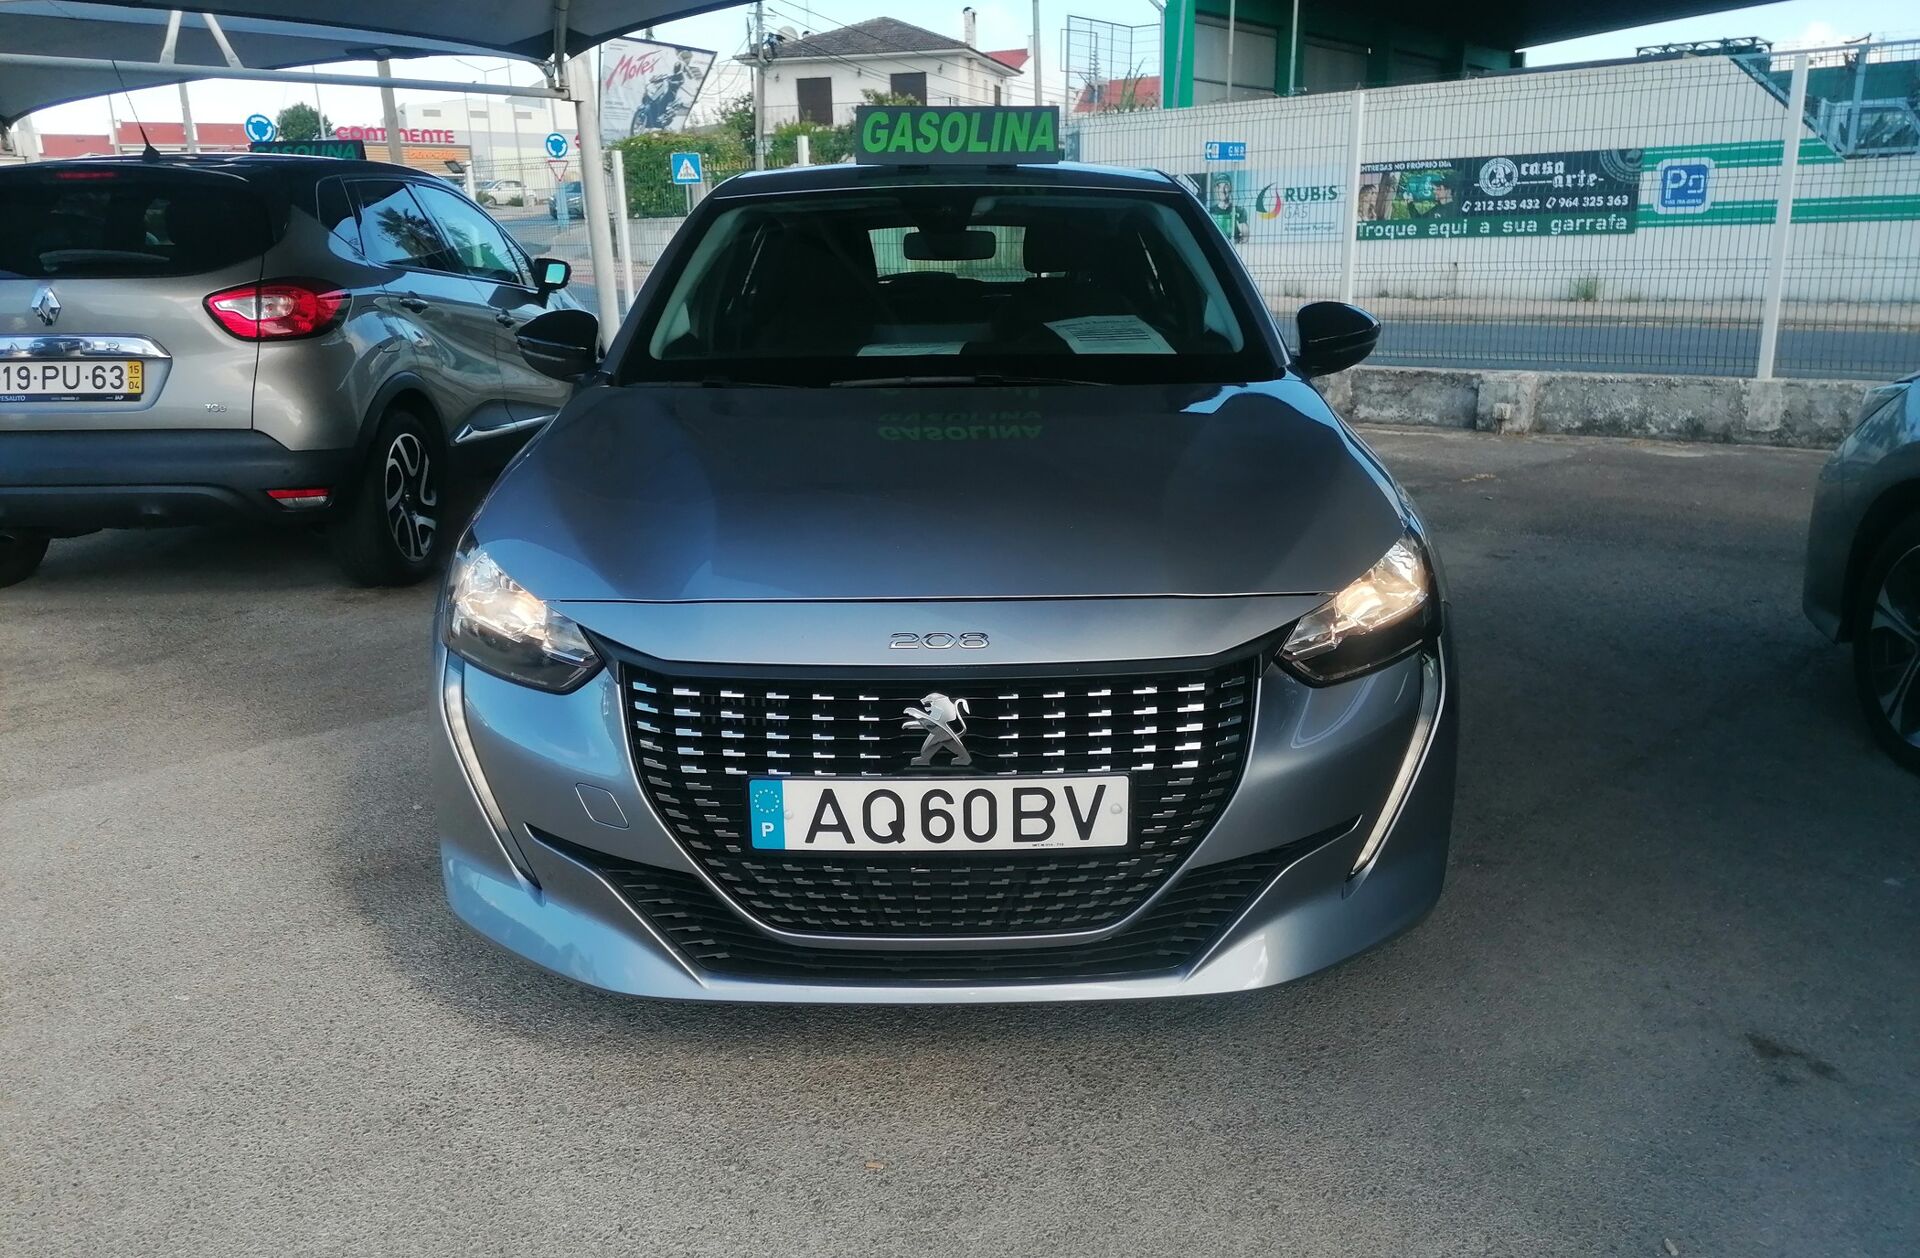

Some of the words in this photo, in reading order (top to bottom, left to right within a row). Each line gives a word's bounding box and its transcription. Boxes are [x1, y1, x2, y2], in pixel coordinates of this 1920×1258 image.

[335, 126, 455, 144] CONTNENTE
[862, 111, 1056, 154] GASOLINA
[1520, 160, 1565, 176] casa
[1473, 201, 1495, 212] 212
[1496, 200, 1517, 211] 535
[1519, 198, 1540, 210] 432
[1558, 197, 1579, 208] 964
[1582, 196, 1604, 207] 325
[1606, 195, 1629, 206] 363
[1357, 222, 1417, 239] Troque
[1428, 219, 1468, 238] aqui
[1479, 221, 1490, 233] a
[1502, 218, 1538, 233] sua
[1550, 214, 1628, 236] garrafa
[129, 365, 140, 375] 15
[128, 381, 140, 390] 04
[889, 632, 990, 649] 208
[761, 822, 775, 838] P
